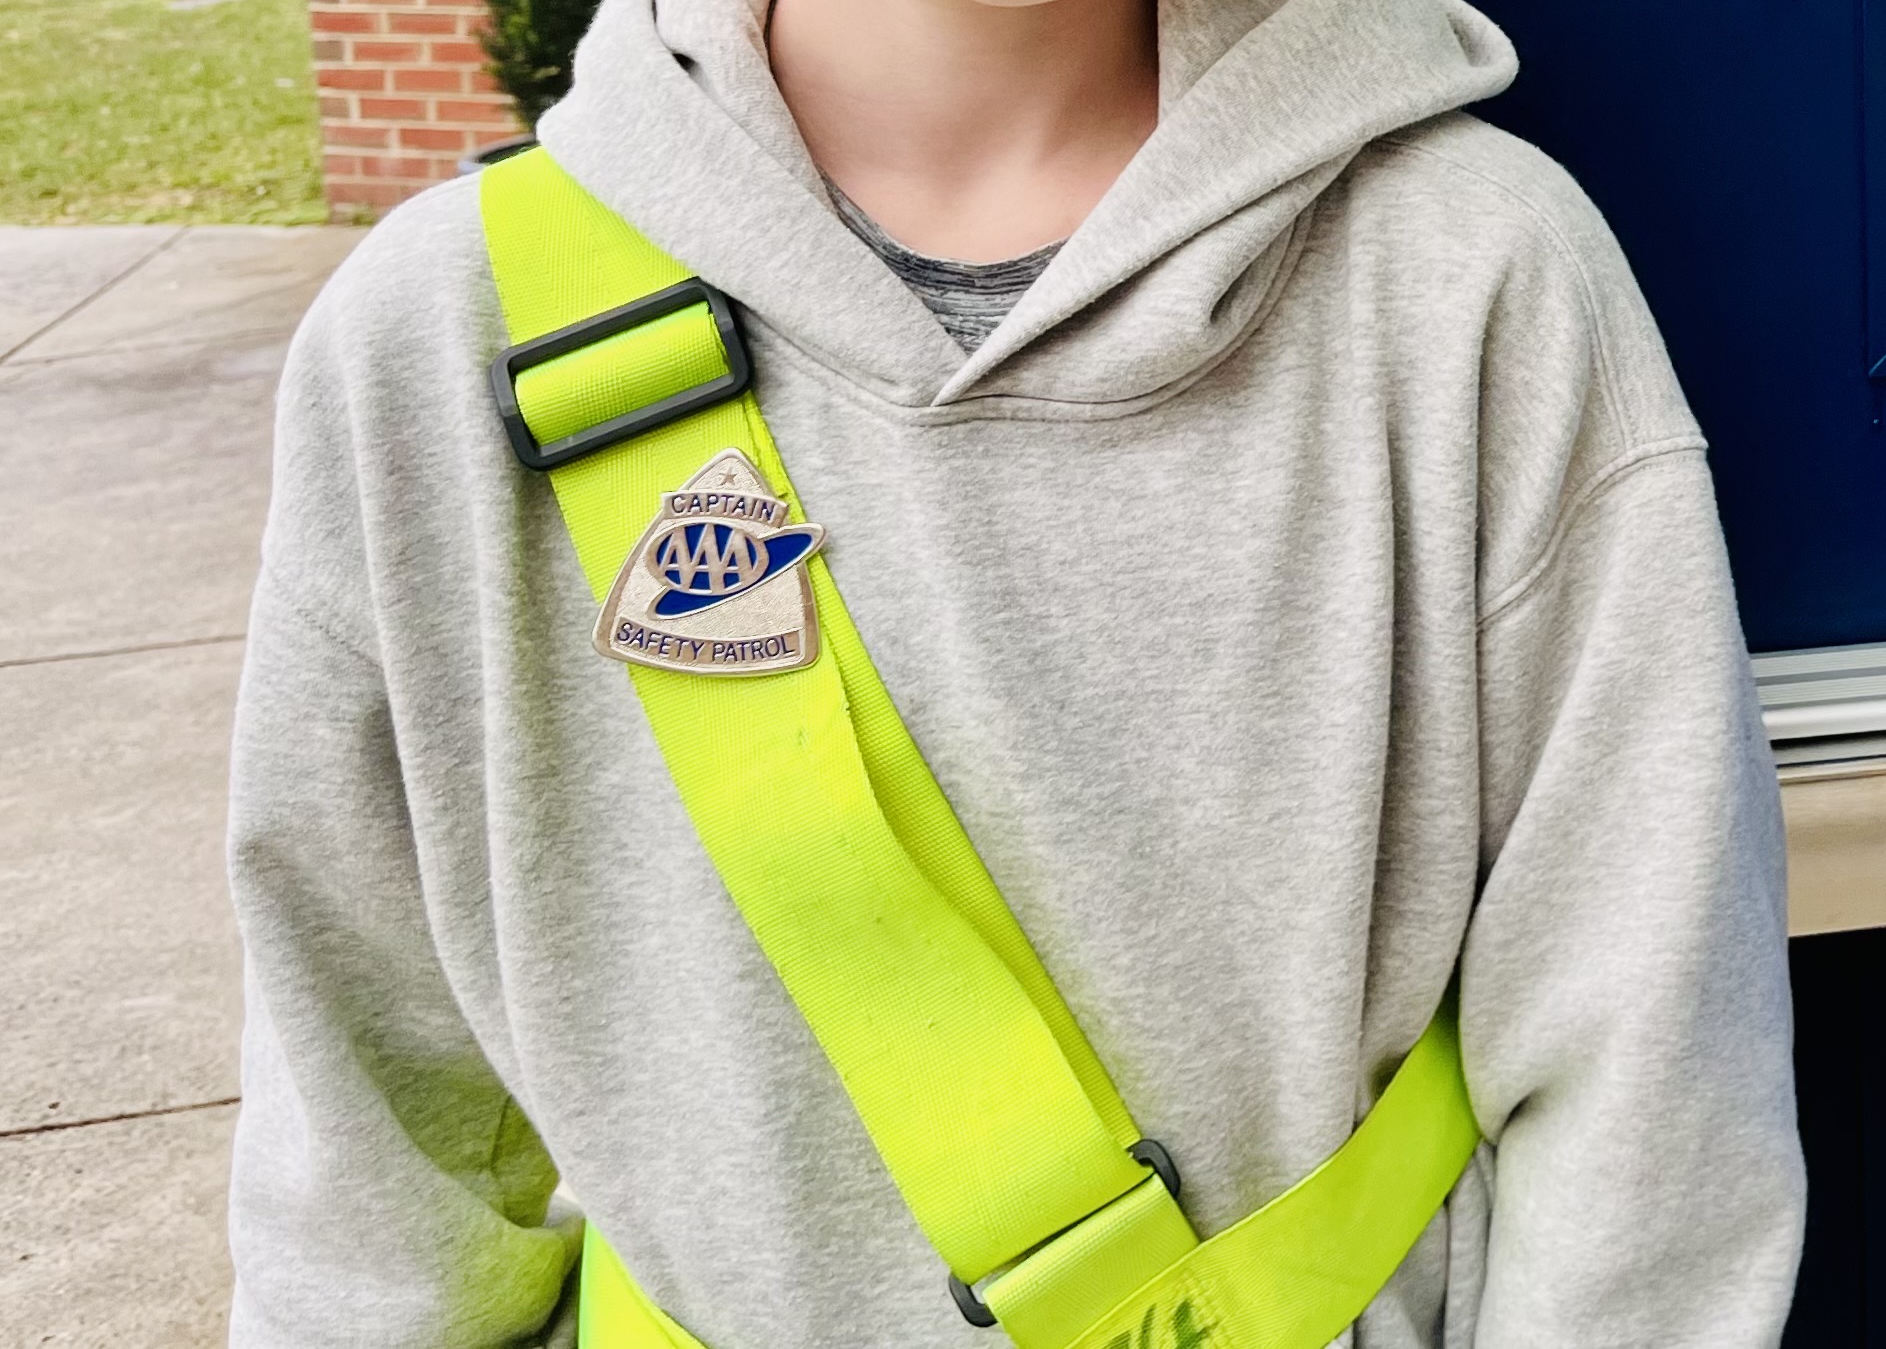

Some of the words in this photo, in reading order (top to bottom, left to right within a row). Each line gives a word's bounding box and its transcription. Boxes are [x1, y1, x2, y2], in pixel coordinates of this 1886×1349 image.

[671, 493, 776, 522] CAPTAIN
[657, 522, 757, 594] AAA
[616, 621, 705, 662] SAFETY
[711, 635, 795, 664] PATROL
